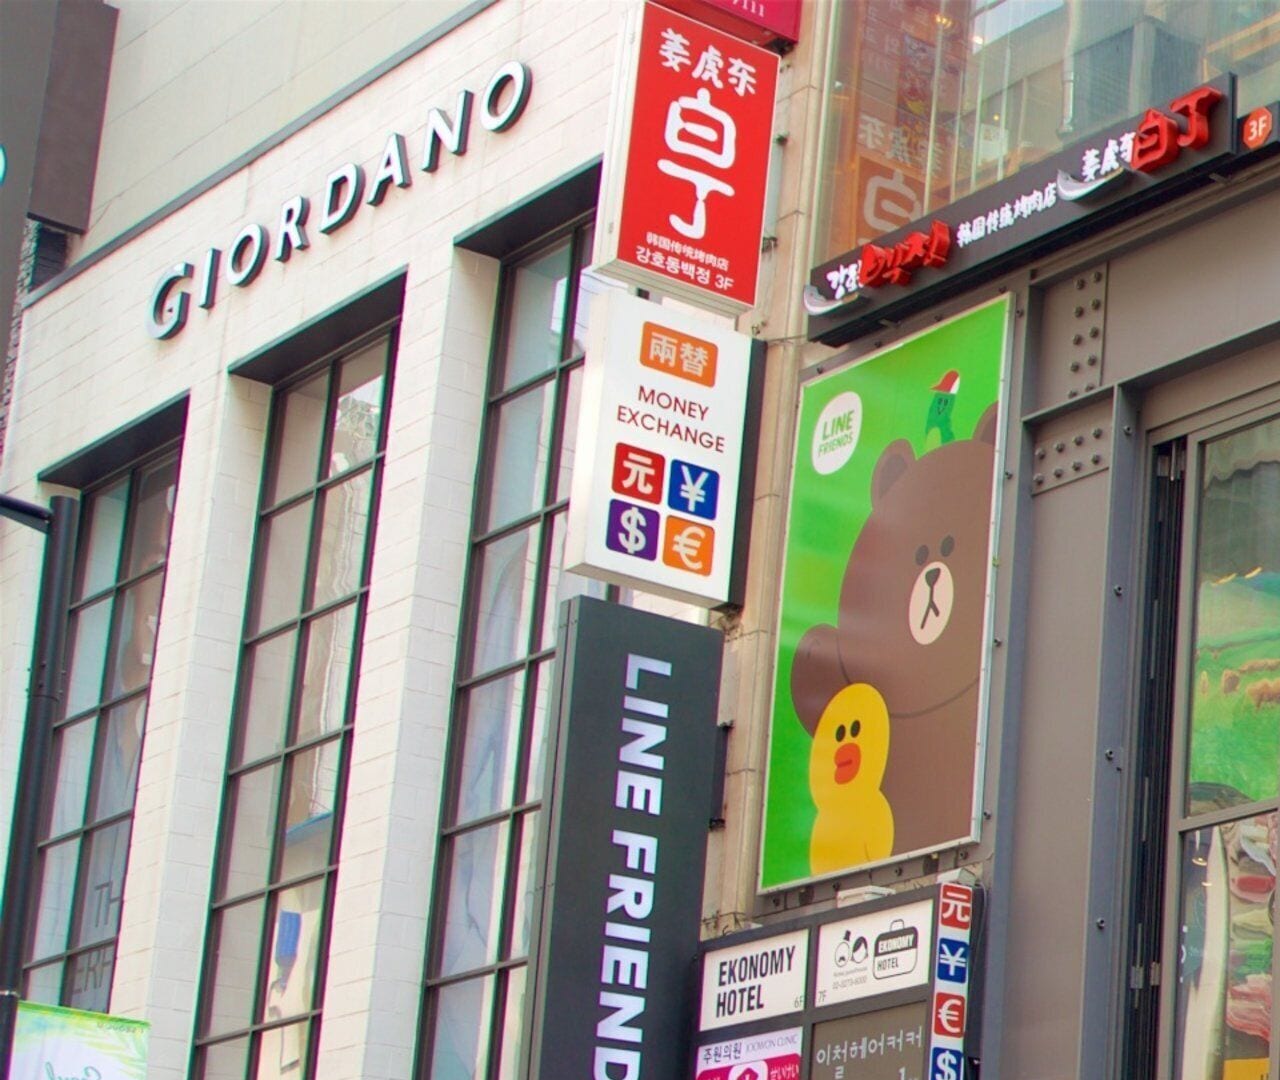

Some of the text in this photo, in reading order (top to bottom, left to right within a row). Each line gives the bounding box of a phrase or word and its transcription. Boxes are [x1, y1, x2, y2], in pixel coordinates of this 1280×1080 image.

[658, 27, 757, 97] 姜虎东
[1247, 115, 1270, 142] 3F
[656, 86, 737, 240] 白丁
[146, 59, 533, 342] GIORDANO
[635, 245, 734, 290] 강호동백정 3F
[635, 383, 711, 422] MONEY
[615, 404, 728, 456] EXCHANGE
[821, 410, 855, 439] LINE
[818, 432, 854, 458] FRIENDS
[620, 450, 657, 494] 元
[679, 464, 712, 512] ¥
[616, 506, 649, 556] $
[672, 525, 708, 572] €
[614, 652, 673, 816] LINE
[941, 890, 972, 924] 元
[878, 934, 914, 953] EKONOMY
[939, 942, 967, 977] ¥
[717, 945, 797, 987] EKONOMY
[877, 959, 900, 972] HOTEL
[715, 983, 765, 1018] HOTEL
[936, 998, 963, 1035] €
[702, 1042, 742, 1064] 주원의원
